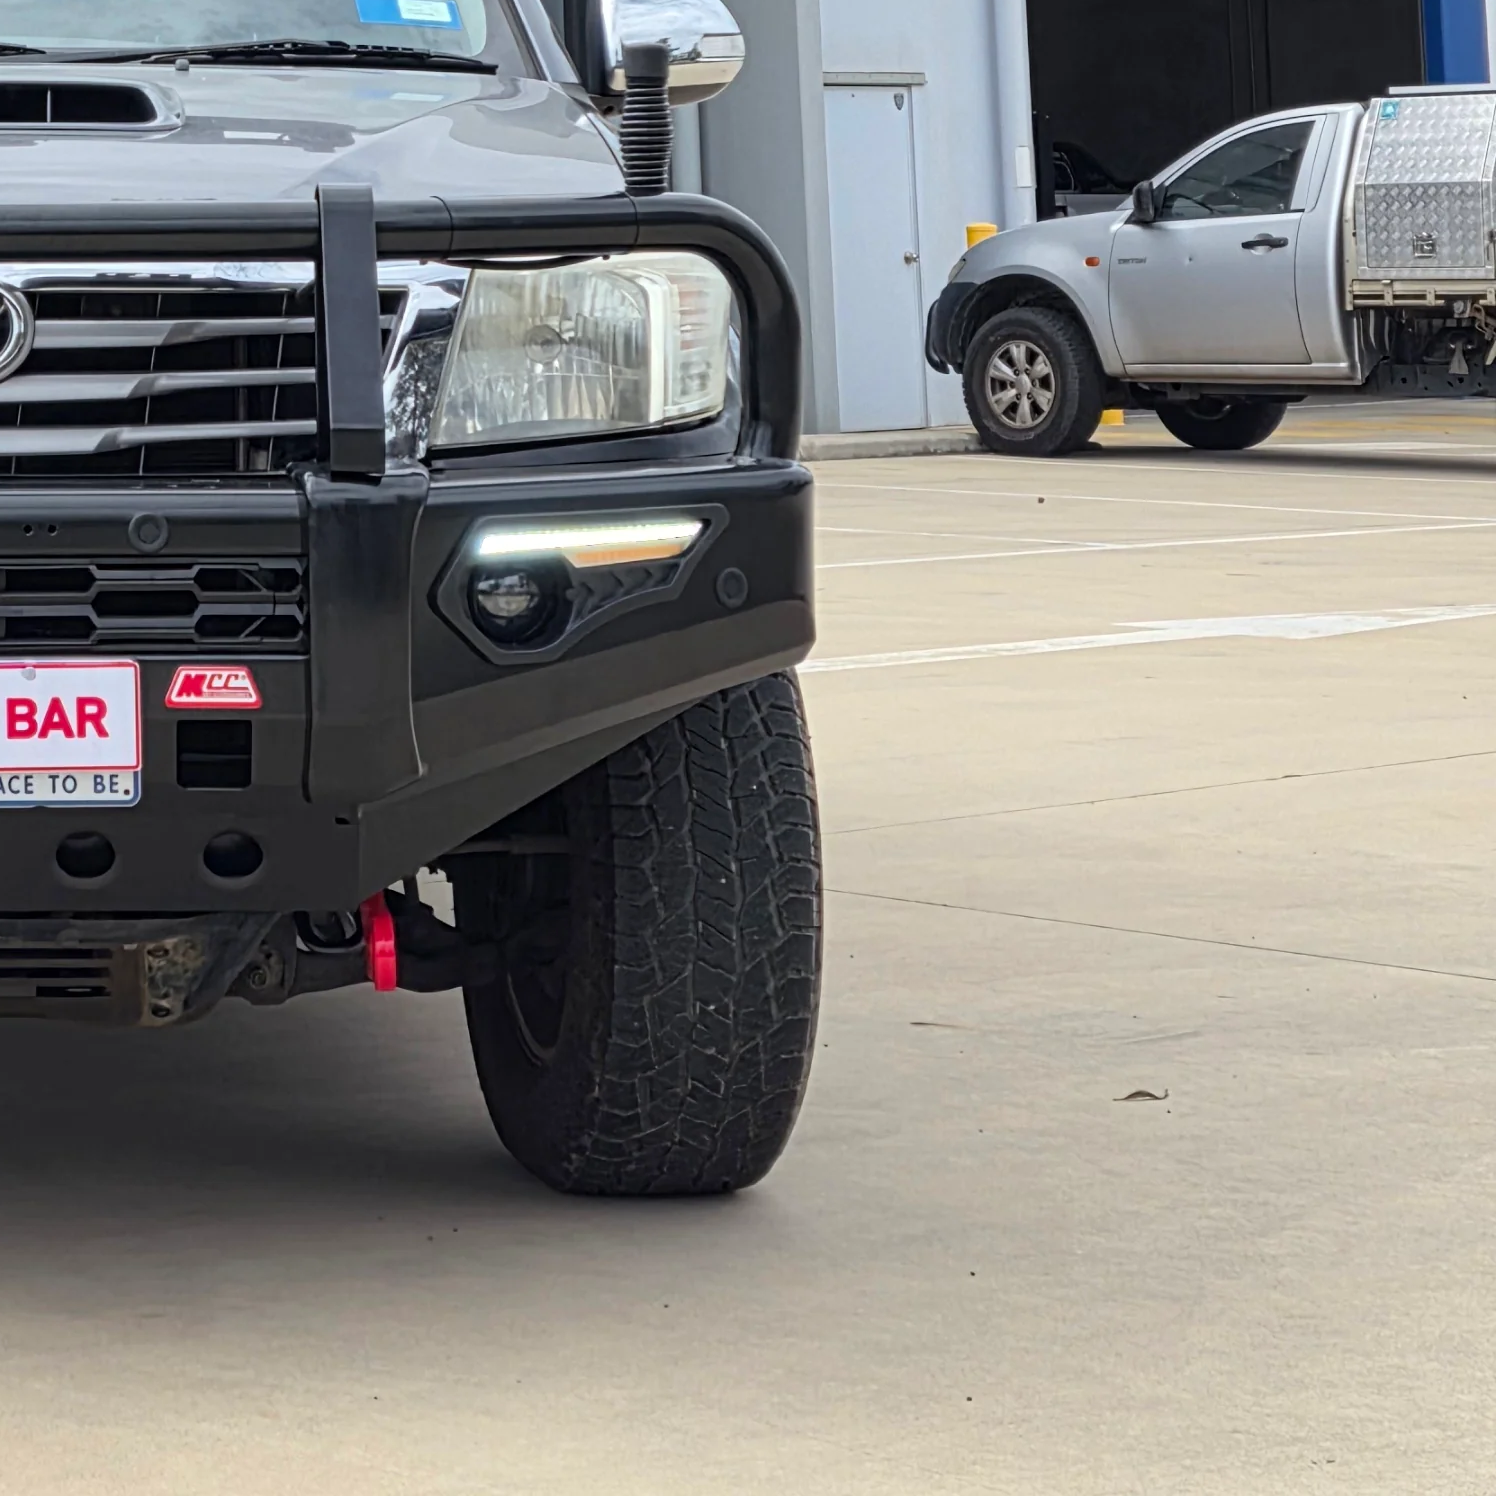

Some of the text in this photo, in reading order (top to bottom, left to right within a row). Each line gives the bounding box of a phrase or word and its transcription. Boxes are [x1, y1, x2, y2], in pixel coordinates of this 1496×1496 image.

[176, 673, 250, 698] MCC
[6, 696, 110, 740] BAR
[48, 774, 78, 795] TO
[93, 774, 120, 795] BE
